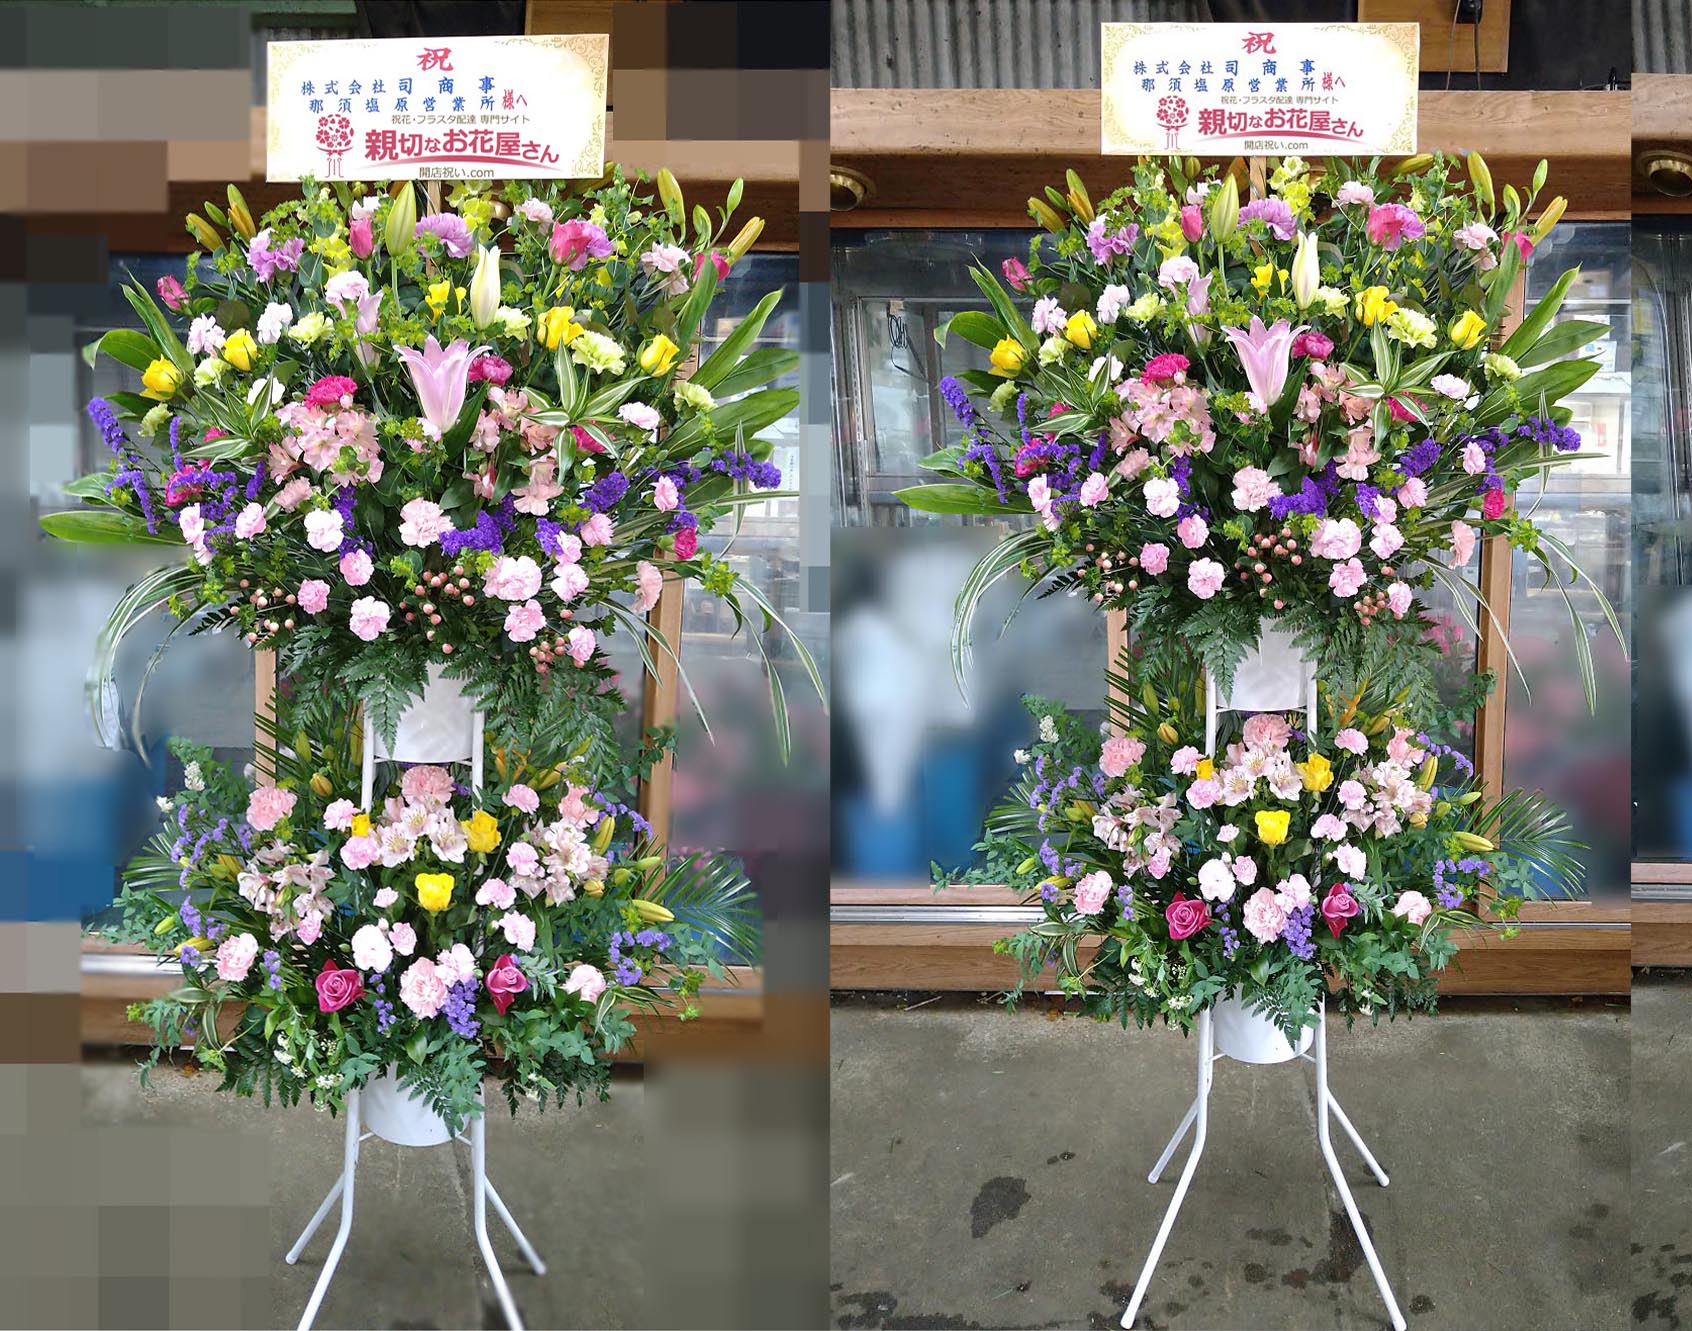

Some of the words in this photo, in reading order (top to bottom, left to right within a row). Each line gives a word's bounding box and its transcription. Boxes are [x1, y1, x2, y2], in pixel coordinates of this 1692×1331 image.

[1242, 32, 1276, 54] 祝
[417, 48, 453, 71] 祝
[1297, 96, 1337, 104] 専門サイト
[481, 115, 529, 124] 専門サイト
[1199, 108, 1363, 138] 親切なお花屋さん
[365, 129, 559, 164] 親切なお花屋さん
[1245, 141, 1308, 150] 開店祝い.com
[420, 167, 494, 178] 開店祝い.com
